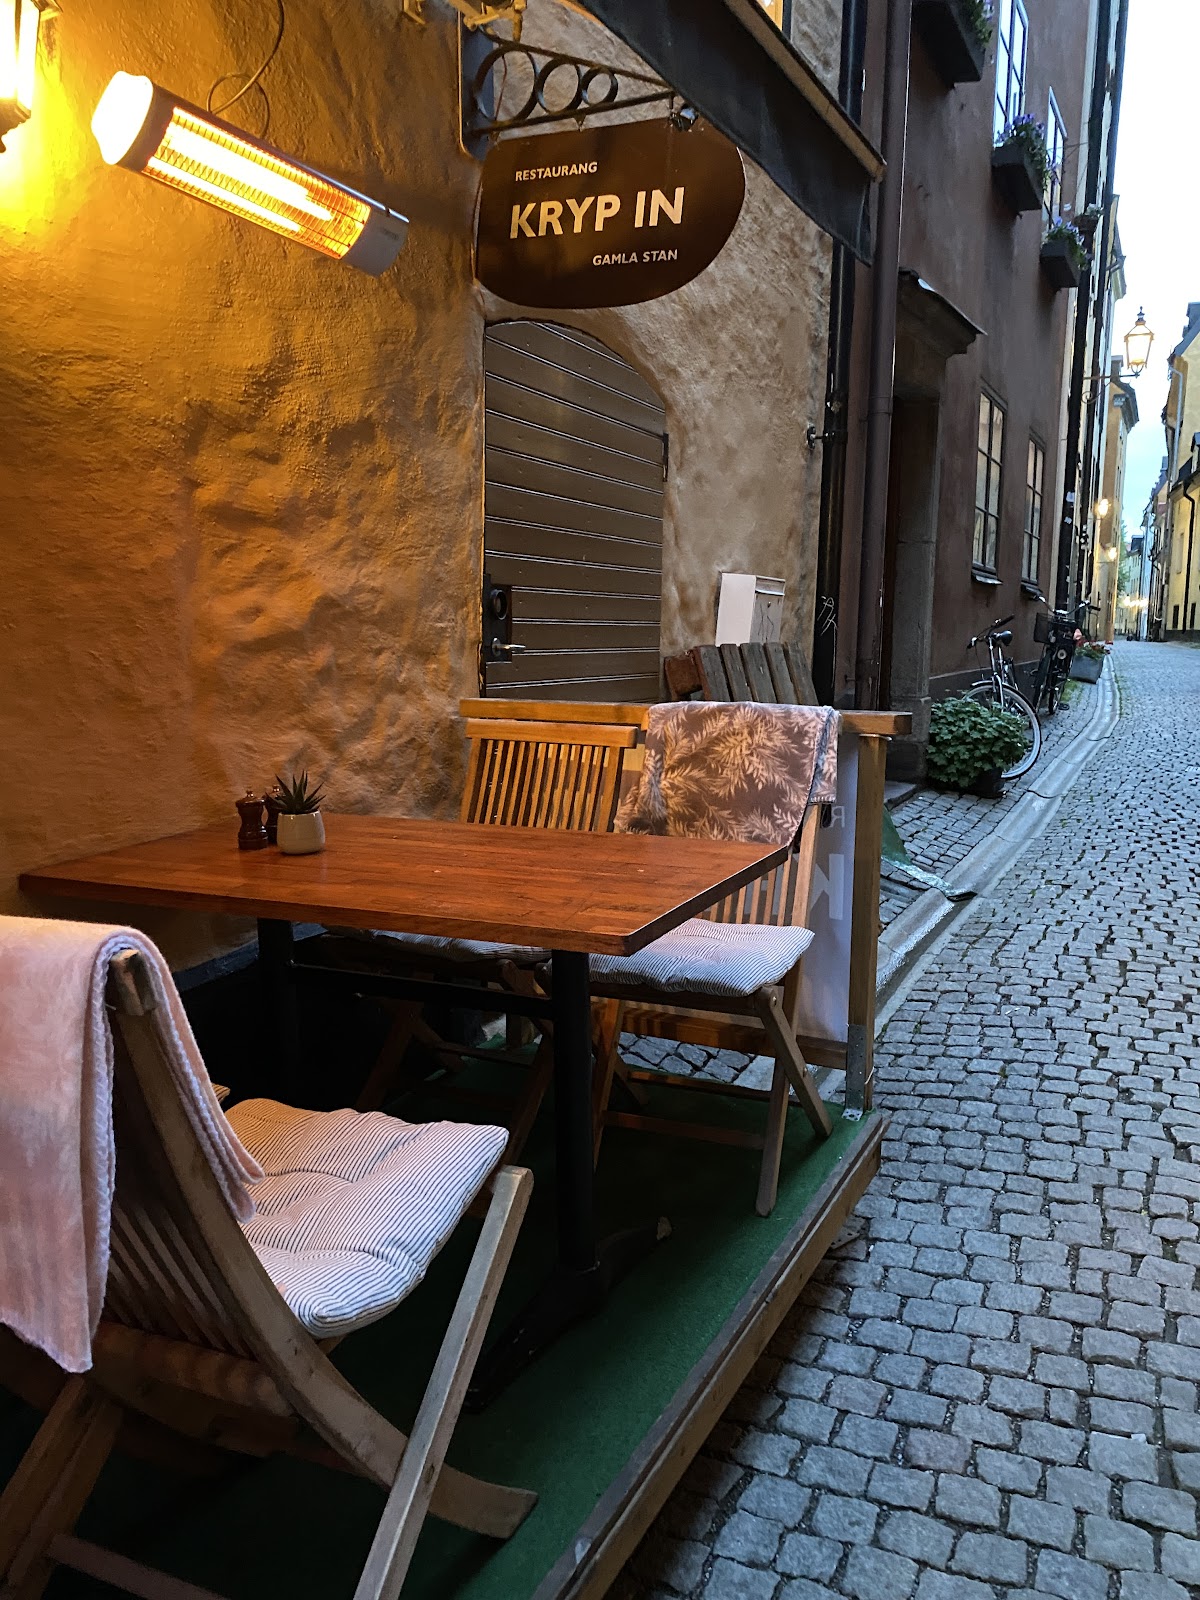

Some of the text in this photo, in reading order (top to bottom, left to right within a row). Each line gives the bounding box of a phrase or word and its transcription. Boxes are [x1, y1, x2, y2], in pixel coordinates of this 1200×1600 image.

[515, 162, 598, 182] RESTAURANG
[510, 186, 685, 239] KRYP IN
[592, 249, 678, 266] GAMLA STAN
